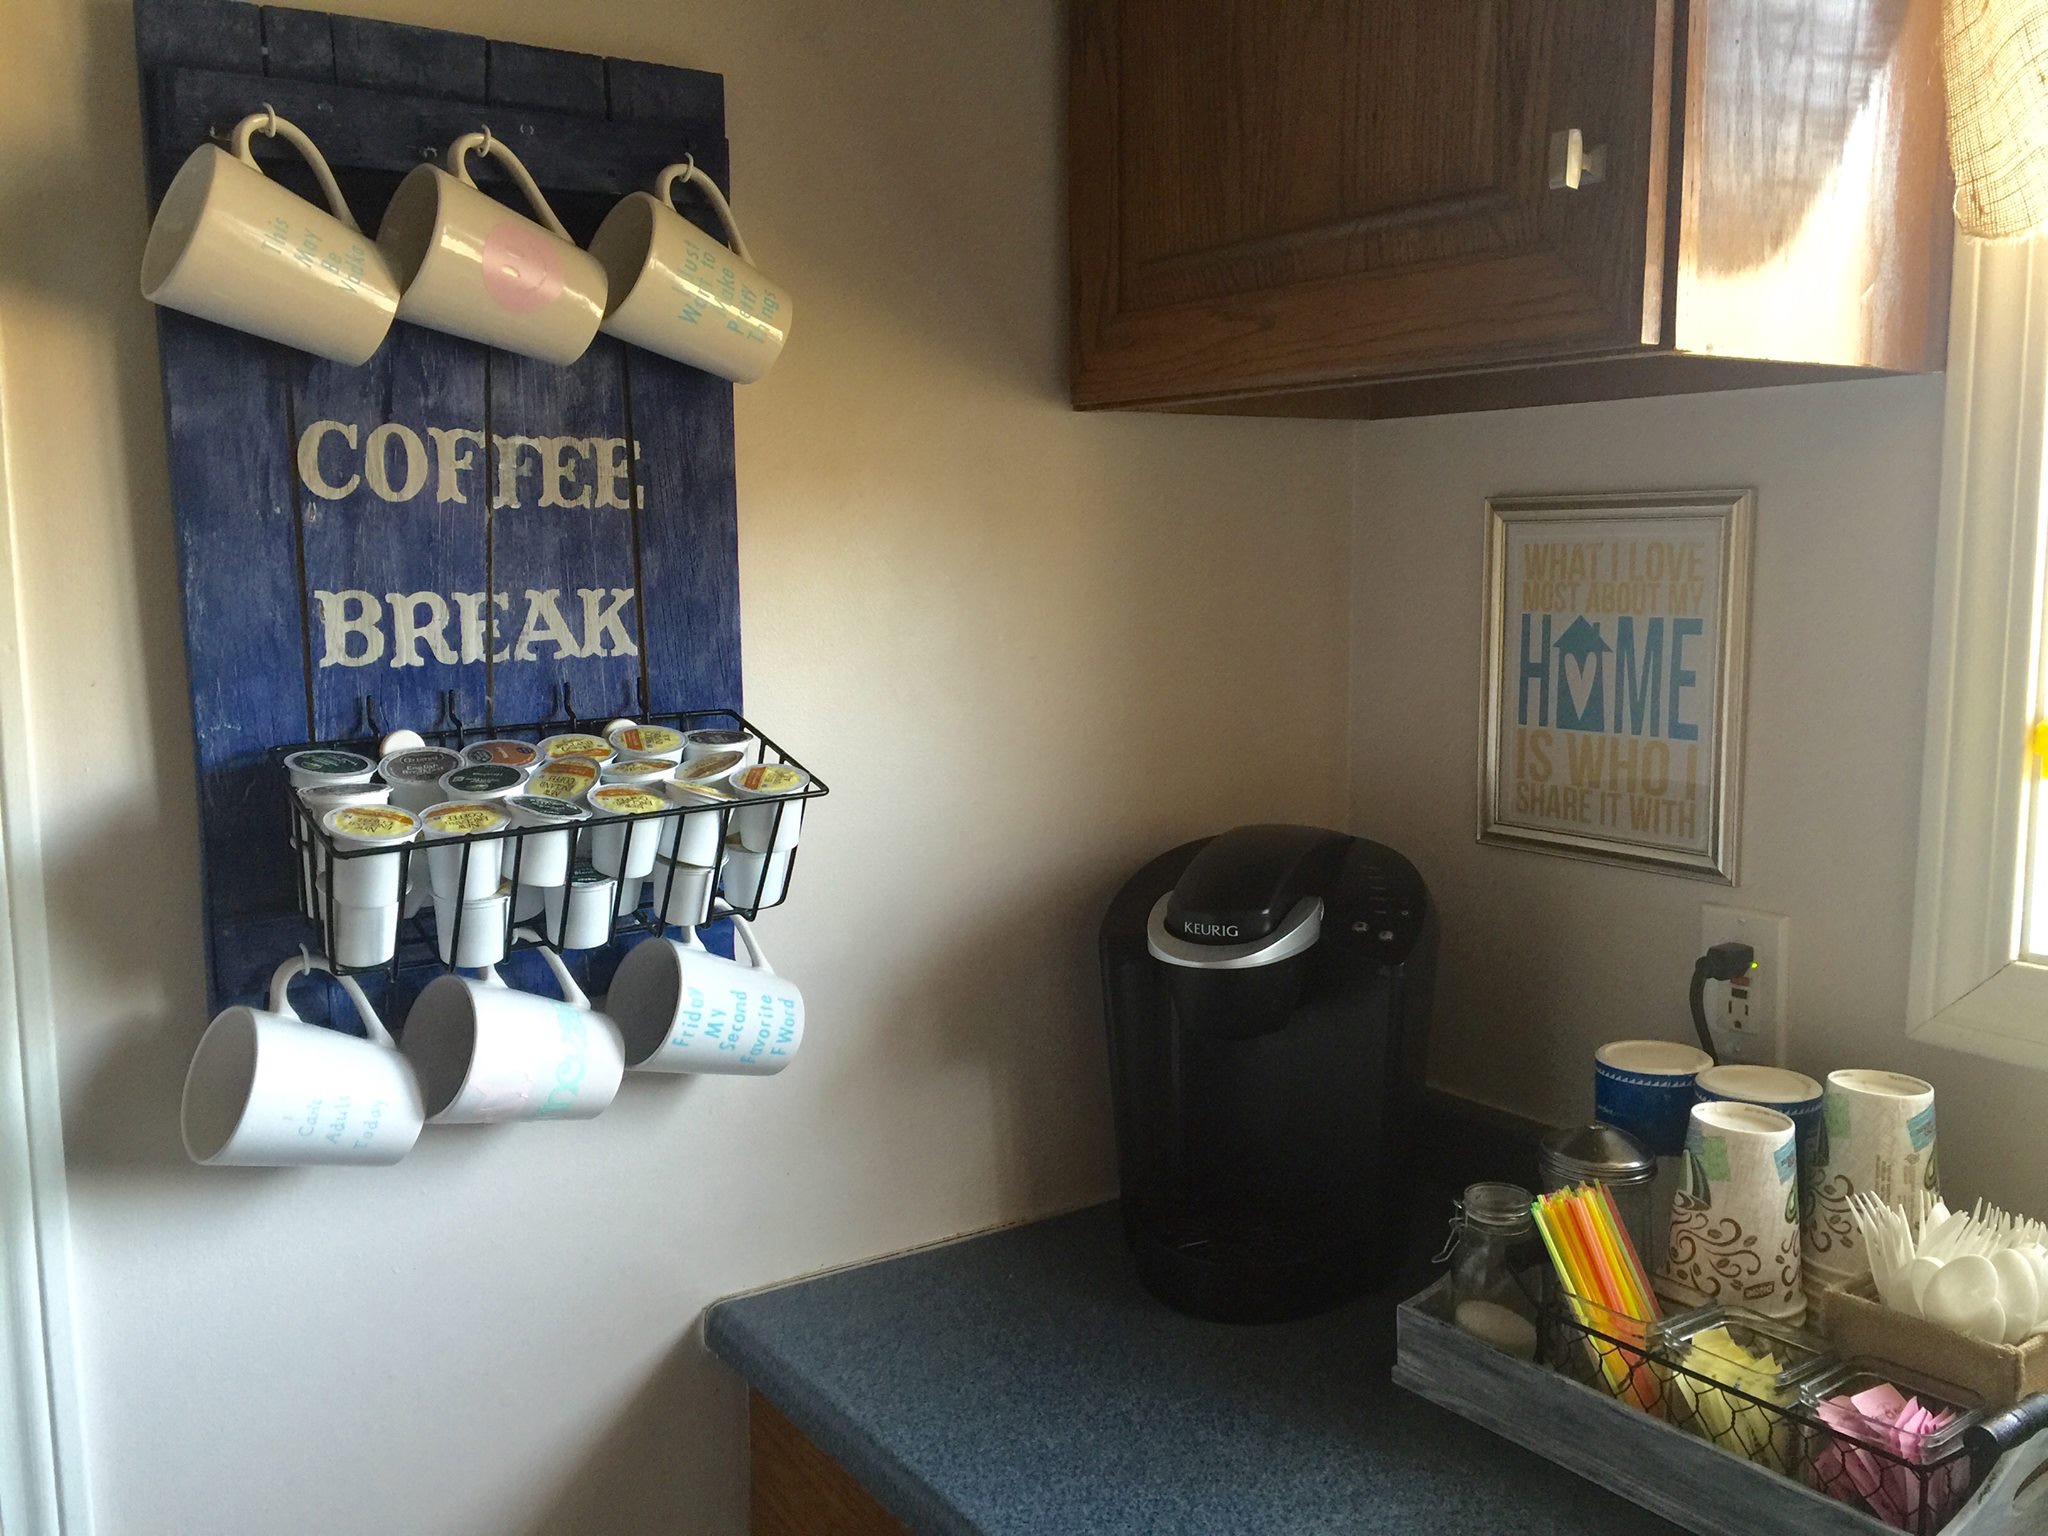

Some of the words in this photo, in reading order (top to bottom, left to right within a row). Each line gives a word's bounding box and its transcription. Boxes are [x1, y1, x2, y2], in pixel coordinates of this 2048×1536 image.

[297, 419, 645, 511] COFFEE
[1523, 543, 1604, 581] WHAT
[1611, 543, 1619, 581] I
[1629, 541, 1705, 582] LOVE
[1522, 580, 1582, 612] MOST
[1585, 581, 1661, 614] ABOUT
[1668, 582, 1704, 615] MY
[314, 588, 640, 669] BREAK
[1516, 728, 1554, 784] IS
[1566, 731, 1671, 798] WHO
[1686, 743, 1697, 801] I
[1515, 780, 1593, 825] SHARE
[1599, 789, 1622, 828] IT
[1629, 794, 1697, 840] WITH
[1184, 921, 1239, 937] KEURIG
[671, 986, 705, 1047] Friday
[704, 1008, 728, 1040] My
[719, 989, 748, 1051] Second
[739, 994, 774, 1065] Favorite
